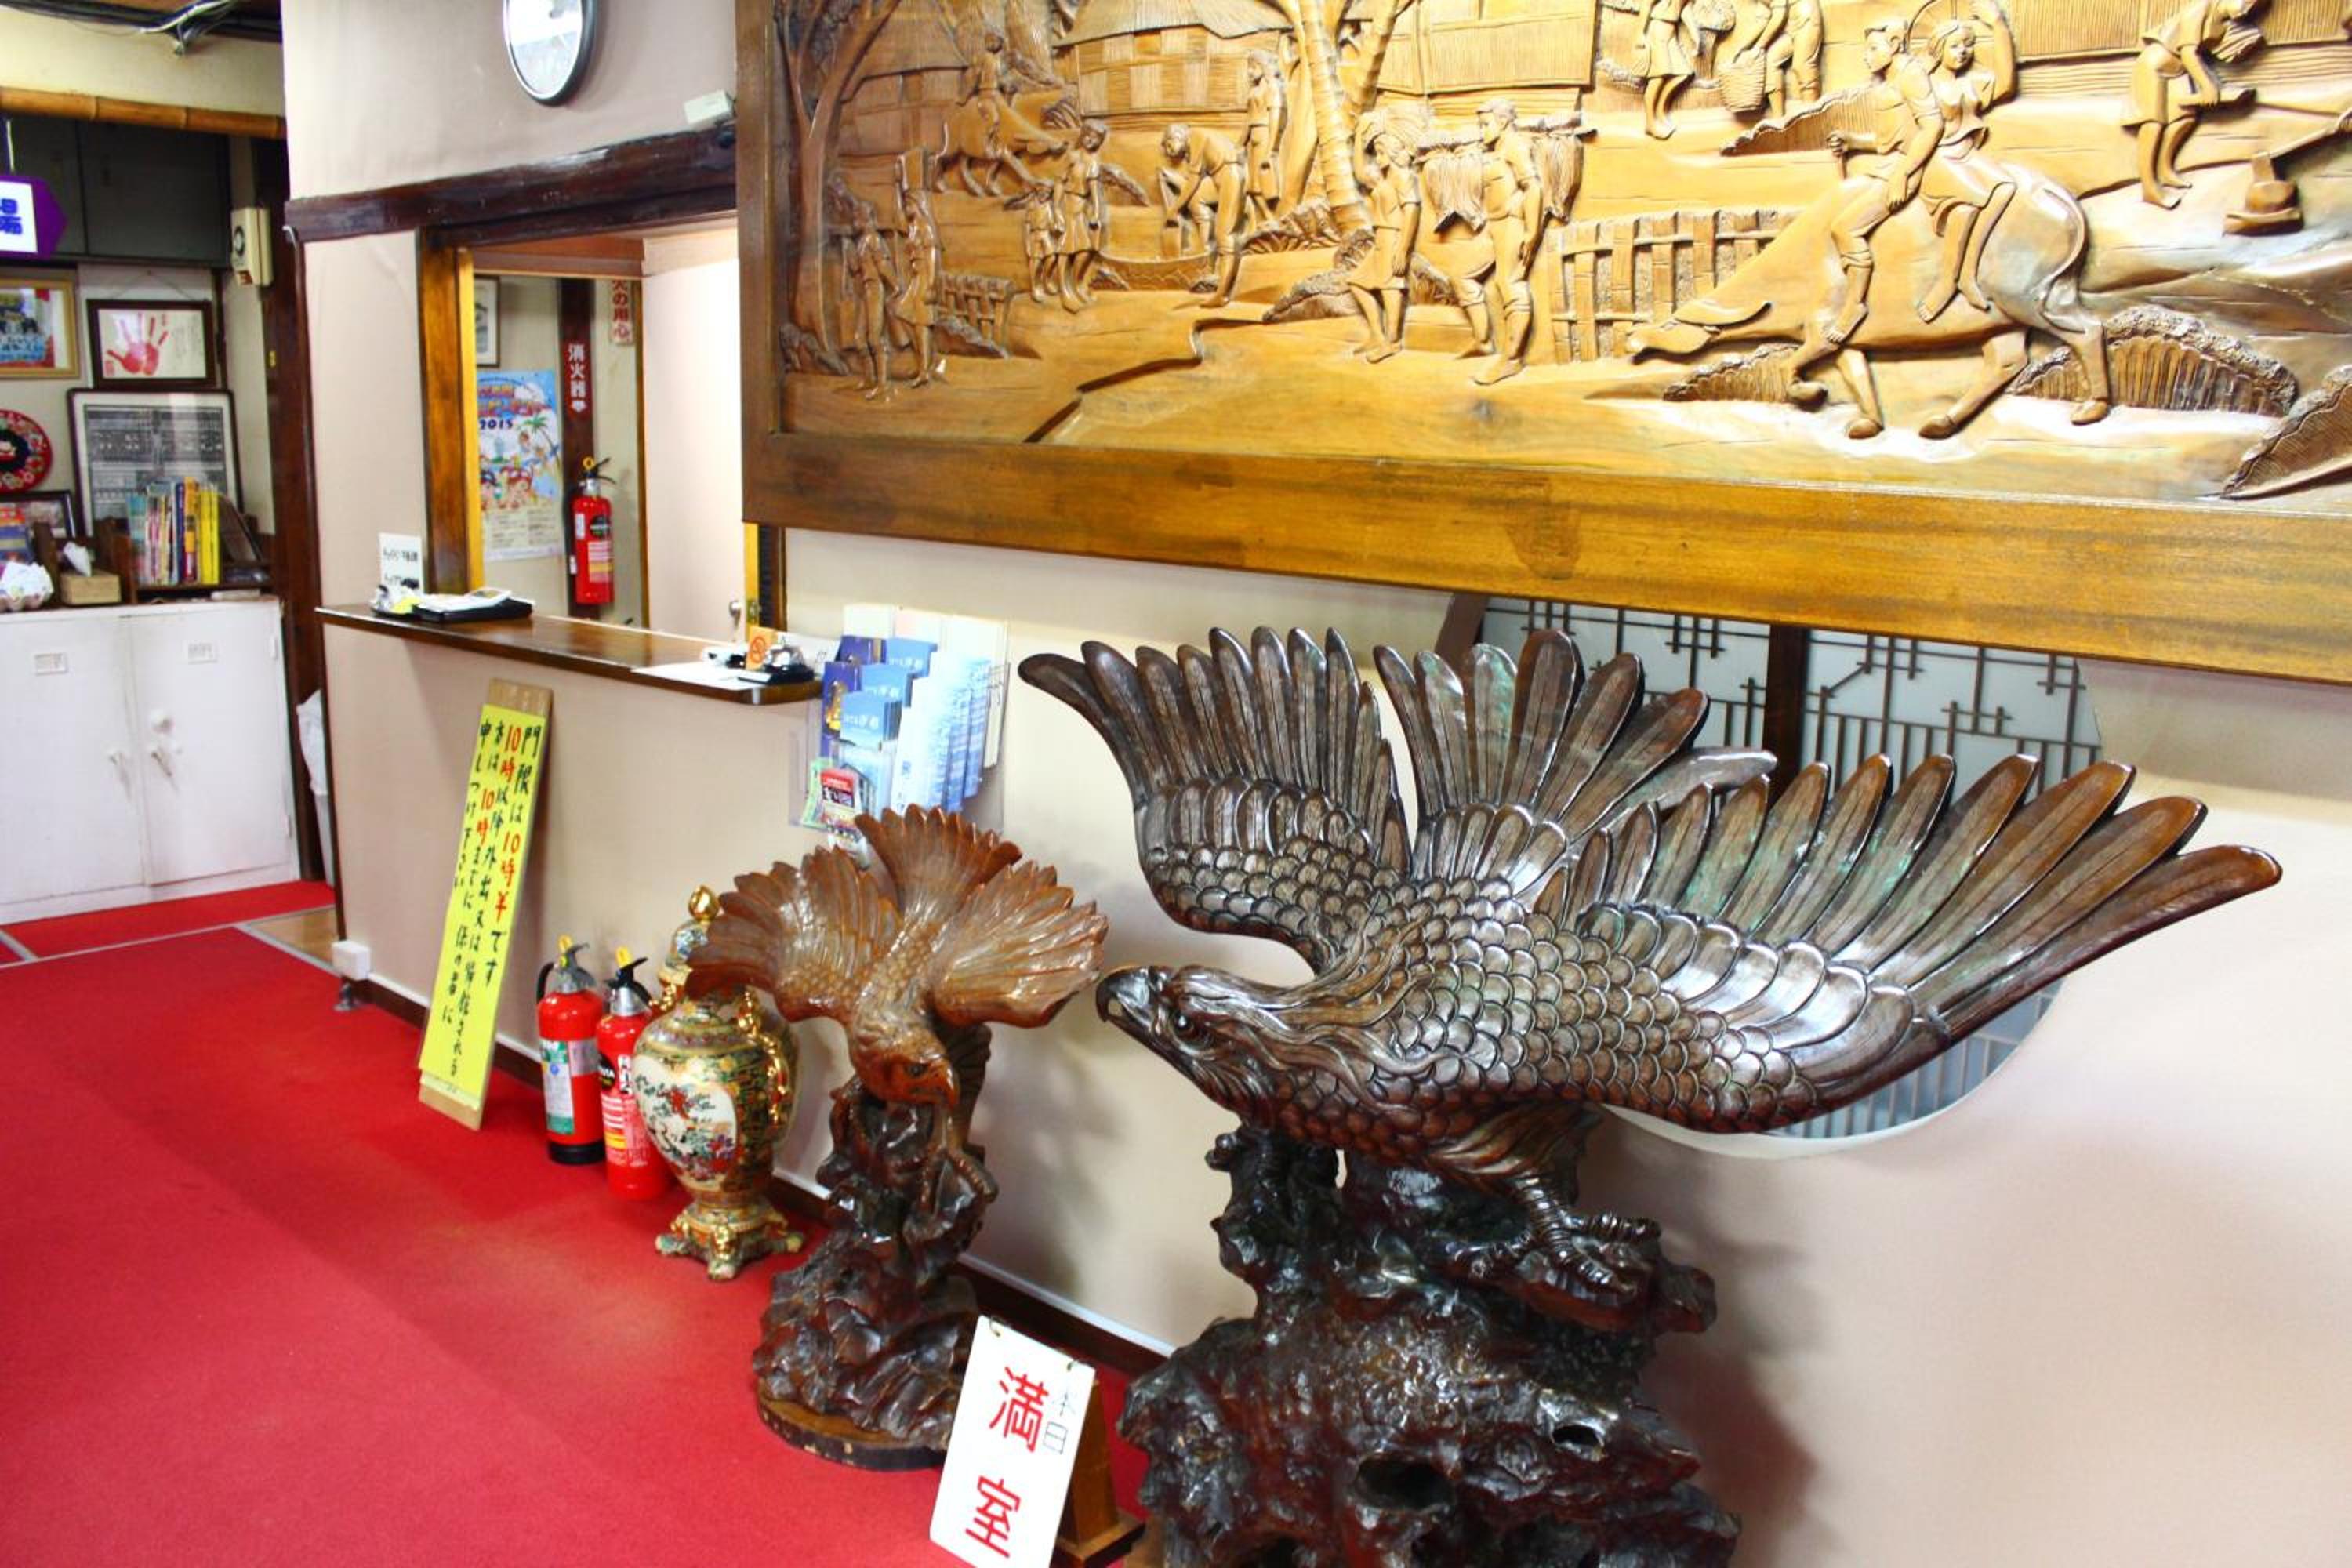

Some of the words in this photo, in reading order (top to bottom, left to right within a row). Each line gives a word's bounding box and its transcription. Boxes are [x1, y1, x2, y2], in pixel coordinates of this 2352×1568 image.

[568, 343, 586, 398] 消火器
[964, 1366, 1049, 1559] 満室
